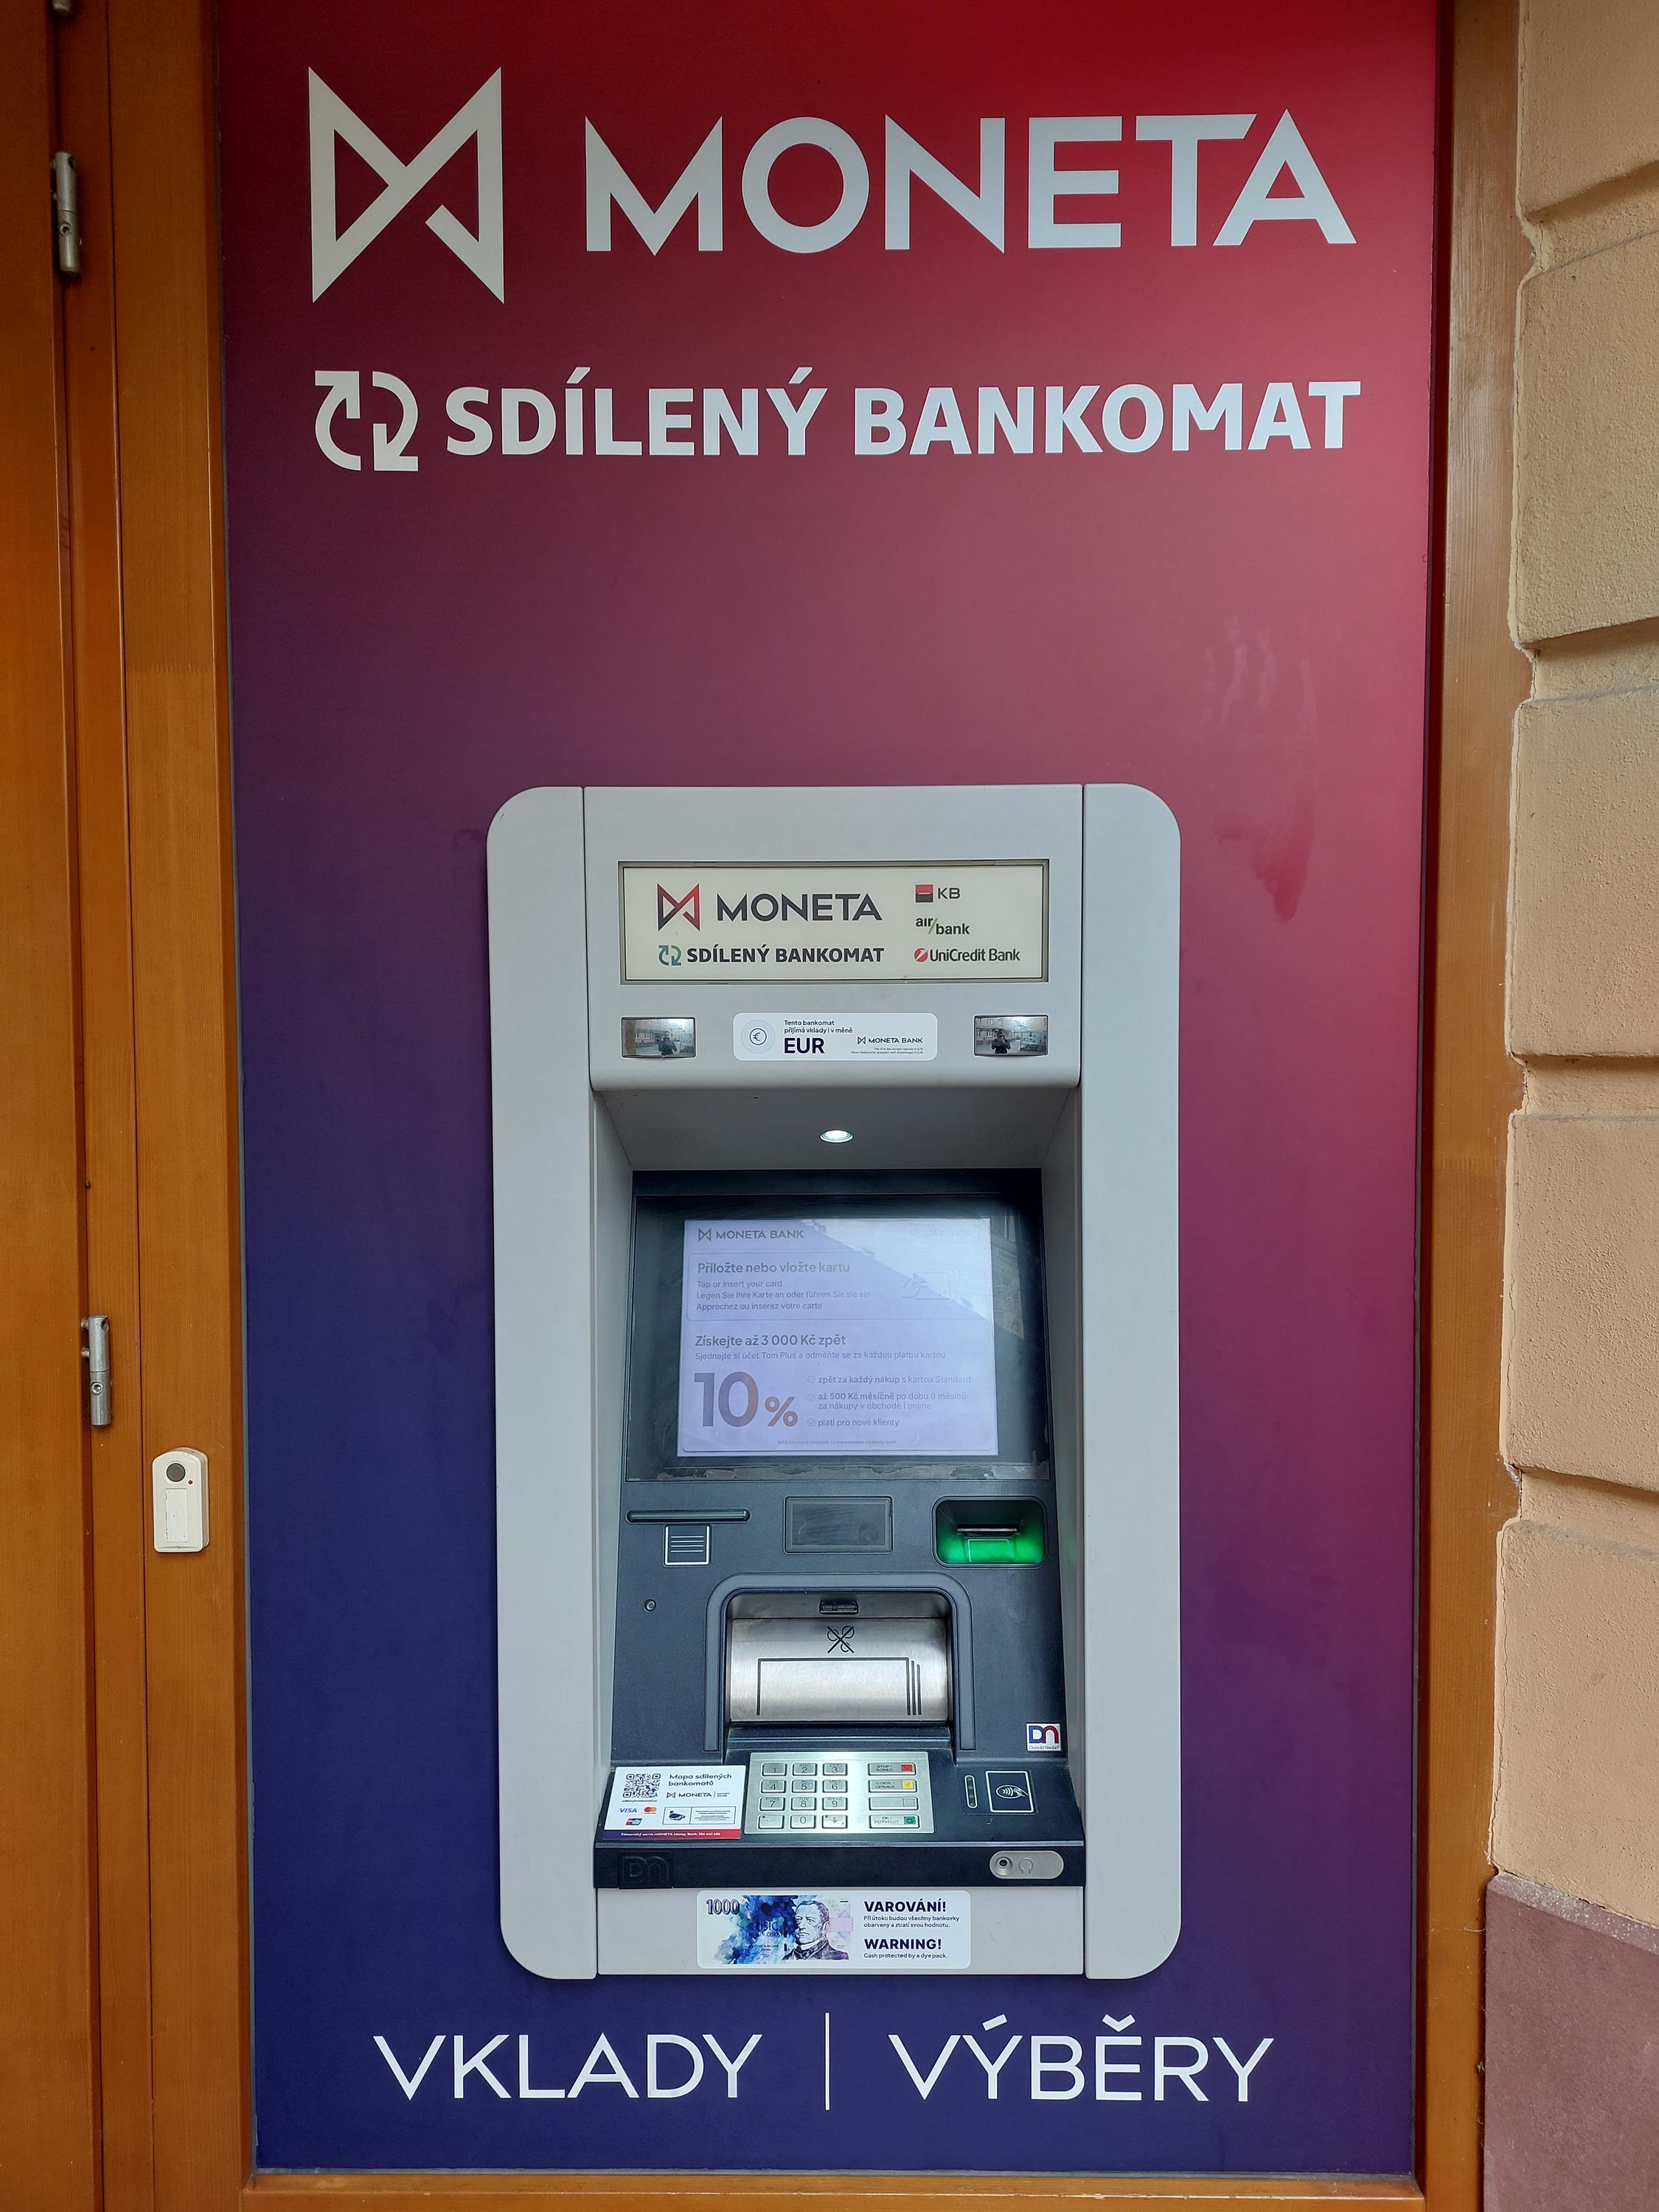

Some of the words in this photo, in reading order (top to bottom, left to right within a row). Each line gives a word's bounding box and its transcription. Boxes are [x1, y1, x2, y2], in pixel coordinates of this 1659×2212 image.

[585, 108, 1357, 256] MONETA
[445, 366, 827, 456] SDÍLENÝ
[854, 380, 1361, 456] BANKOMAT
[937, 887, 961, 899] KB
[717, 892, 883, 922] MONETA
[936, 923, 970, 934] bank
[686, 944, 770, 963] SDÍLENÝ
[775, 947, 885, 962] BANKOMAT
[930, 948, 986, 961] UniCredit
[989, 948, 1020, 961] Bank
[784, 1026, 805, 1034] přijímá
[784, 1037, 825, 1054] EUR
[716, 1230, 767, 1239] MONETA
[770, 1229, 804, 1239] BANK
[698, 1262, 743, 1273] Přiložte
[745, 1262, 777, 1273] nebo
[779, 1261, 816, 1273] vložte
[818, 1262, 850, 1273] kartu
[697, 1281, 711, 1289] Tap
[697, 1292, 720, 1301] Legen
[697, 1303, 737, 1312] Approchez
[695, 1335, 742, 1349] Získejte
[745, 1335, 759, 1346] až
[761, 1335, 768, 1346] 3
[771, 1335, 798, 1346] 000
[801, 1334, 816, 1346] Kč
[818, 1334, 846, 1348] zpět
[695, 1352, 731, 1361] Sjednejte
[733, 1352, 740, 1360] si
[742, 1352, 759, 1360] účet
[894, 1351, 919, 1360] platbu
[818, 1376, 836, 1385] zpět
[849, 1376, 873, 1385] každý
[875, 1375, 900, 1385] nákup
[848, 1392, 858, 1400] Kč
[860, 1392, 894, 1400] měsíčně
[896, 1393, 905, 1402] po
[830, 1402, 858, 1411] nákupy
[818, 1418, 835, 1427] platí
[873, 1418, 900, 1427] klienty
[706, 1899, 740, 1916] 1000
[863, 1898, 947, 1912] VAROVÁNÍ!
[863, 1938, 942, 1950] WARNING!
[373, 2033, 762, 2101] VKLADY
[888, 2014, 1275, 2103] VÝBĚRY
